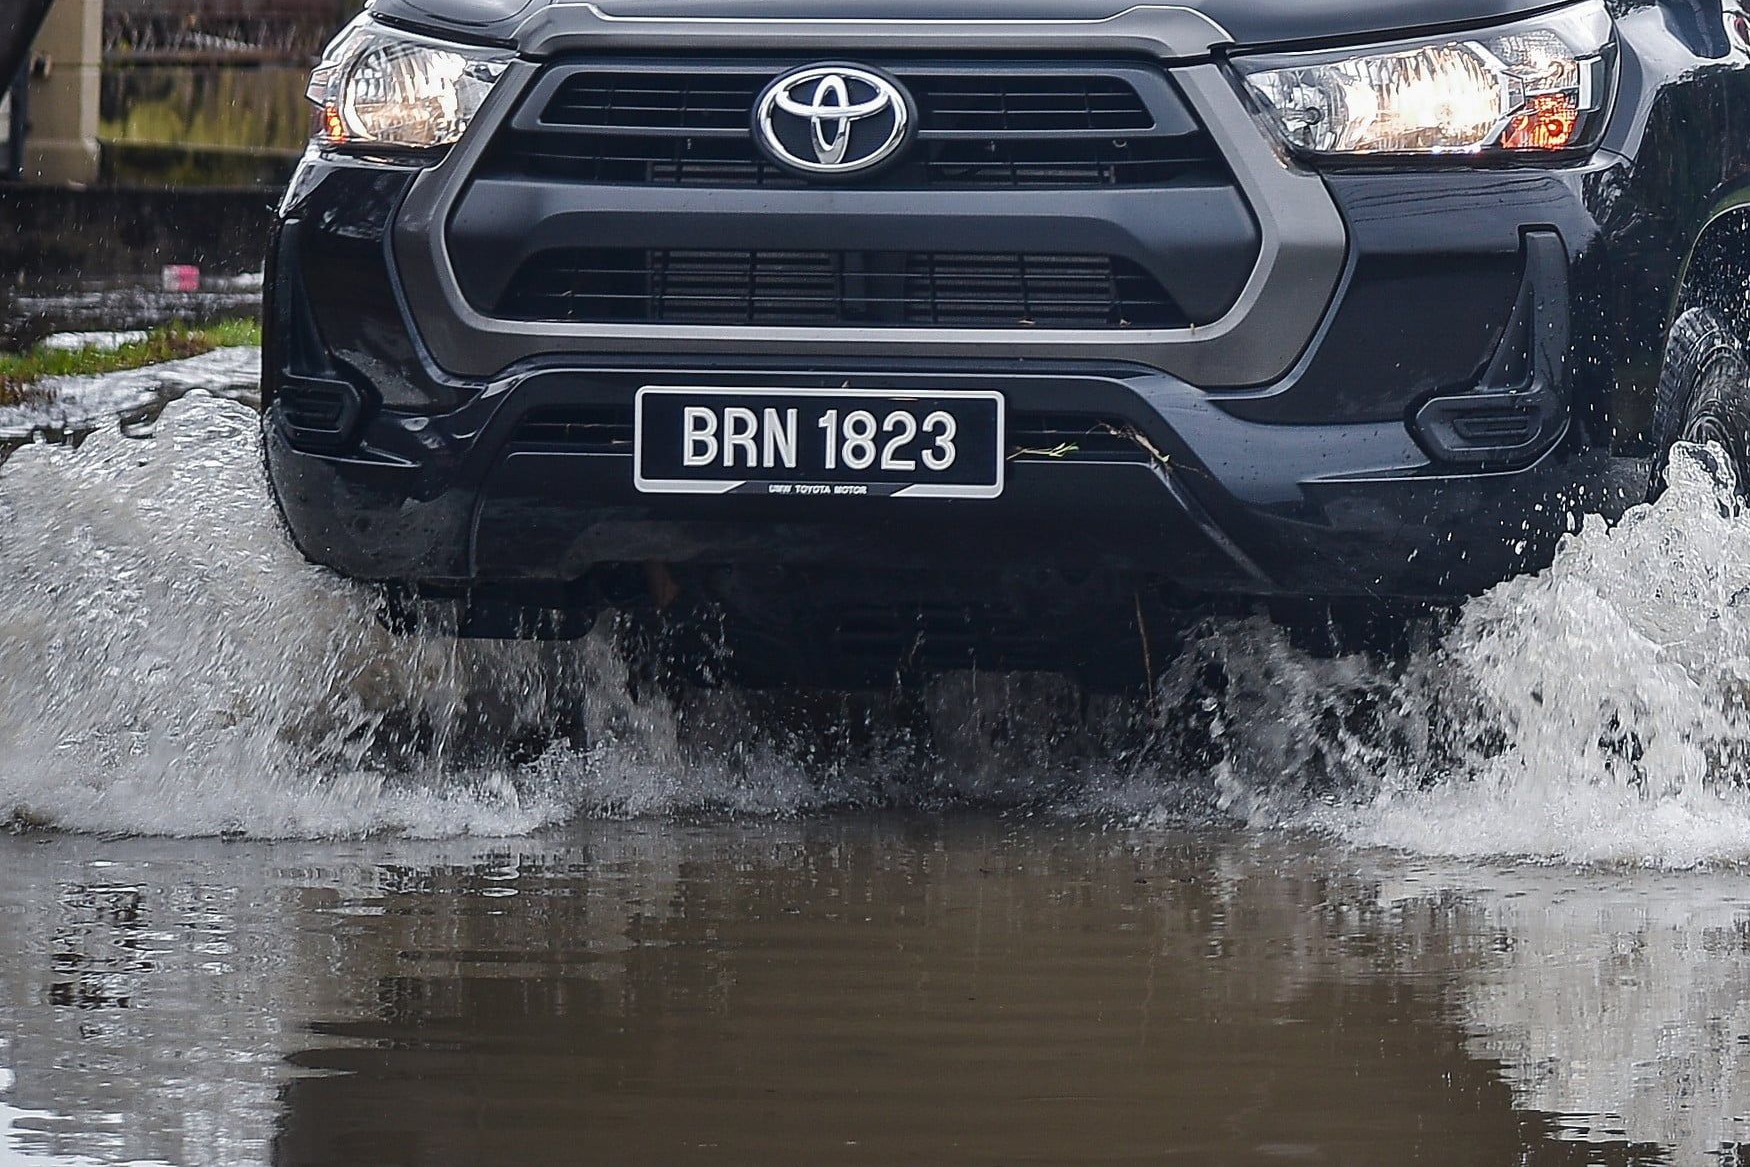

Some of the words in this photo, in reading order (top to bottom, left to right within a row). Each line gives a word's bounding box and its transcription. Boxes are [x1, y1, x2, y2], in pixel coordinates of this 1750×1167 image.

[683, 406, 798, 468] BRN
[818, 409, 958, 472] 1823
[795, 484, 831, 495] TOYOTA
[833, 485, 868, 495] MOTOR
